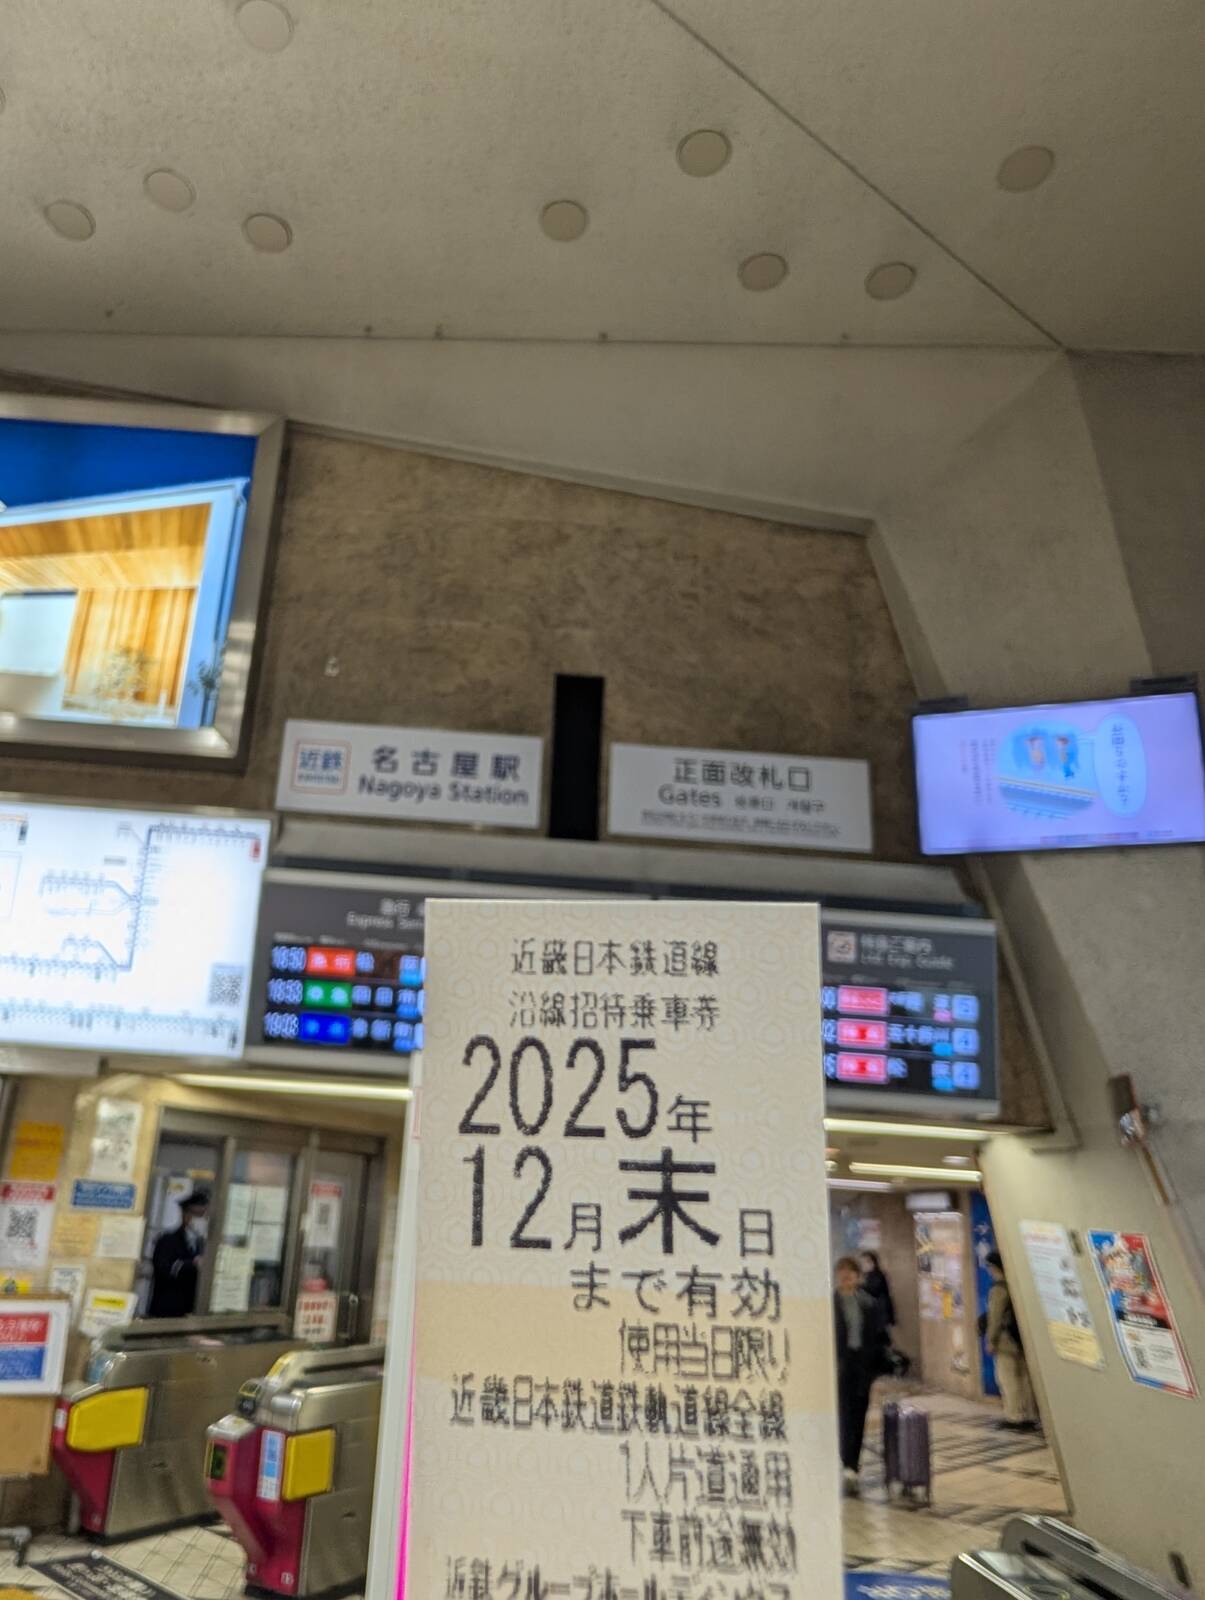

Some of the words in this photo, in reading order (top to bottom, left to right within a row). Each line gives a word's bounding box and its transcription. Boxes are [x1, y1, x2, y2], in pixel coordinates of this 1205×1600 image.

[299, 749, 343, 770] 近鉄
[373, 745, 520, 781] 名古屋駅
[674, 756, 811, 792] 正面改札口
[357, 774, 441, 804] Nagoya
[449, 781, 529, 806] Station
[657, 783, 721, 807] Gates
[510, 938, 720, 977] 近畿日本鉄道線
[509, 990, 720, 1032] 沿線招待乗車券
[458, 1033, 712, 1143] 2025年
[463, 1144, 775, 1258] 12月末日
[570, 1260, 781, 1321] まで有効
[618, 1317, 791, 1384] 使用当日限り
[619, 1439, 793, 1511] 1人片道通用
